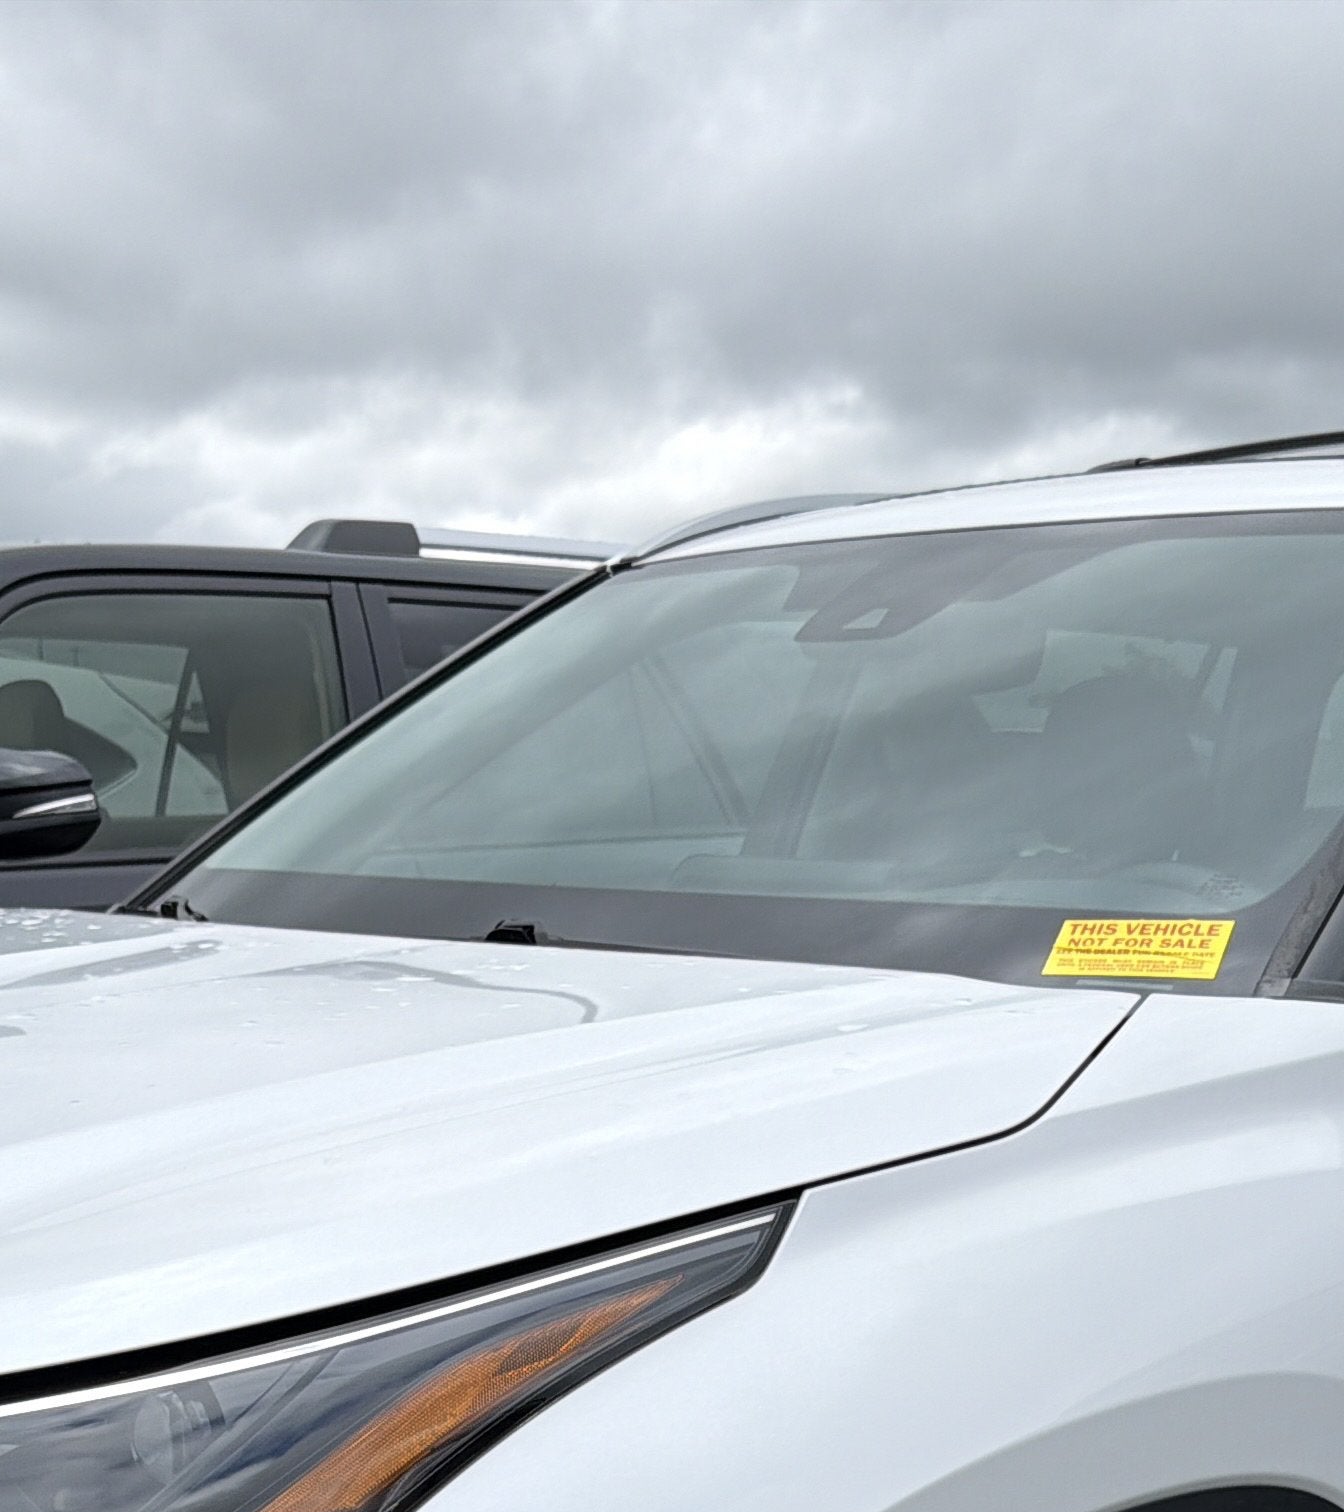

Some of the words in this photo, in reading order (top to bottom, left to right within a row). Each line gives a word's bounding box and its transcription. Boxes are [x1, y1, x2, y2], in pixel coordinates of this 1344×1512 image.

[1070, 923, 1119, 936] THIS
[1126, 923, 1223, 937] VEHICLE
[1067, 938, 1104, 948] NOT
[1113, 938, 1154, 949] FOR
[1158, 938, 1212, 950] SALE
